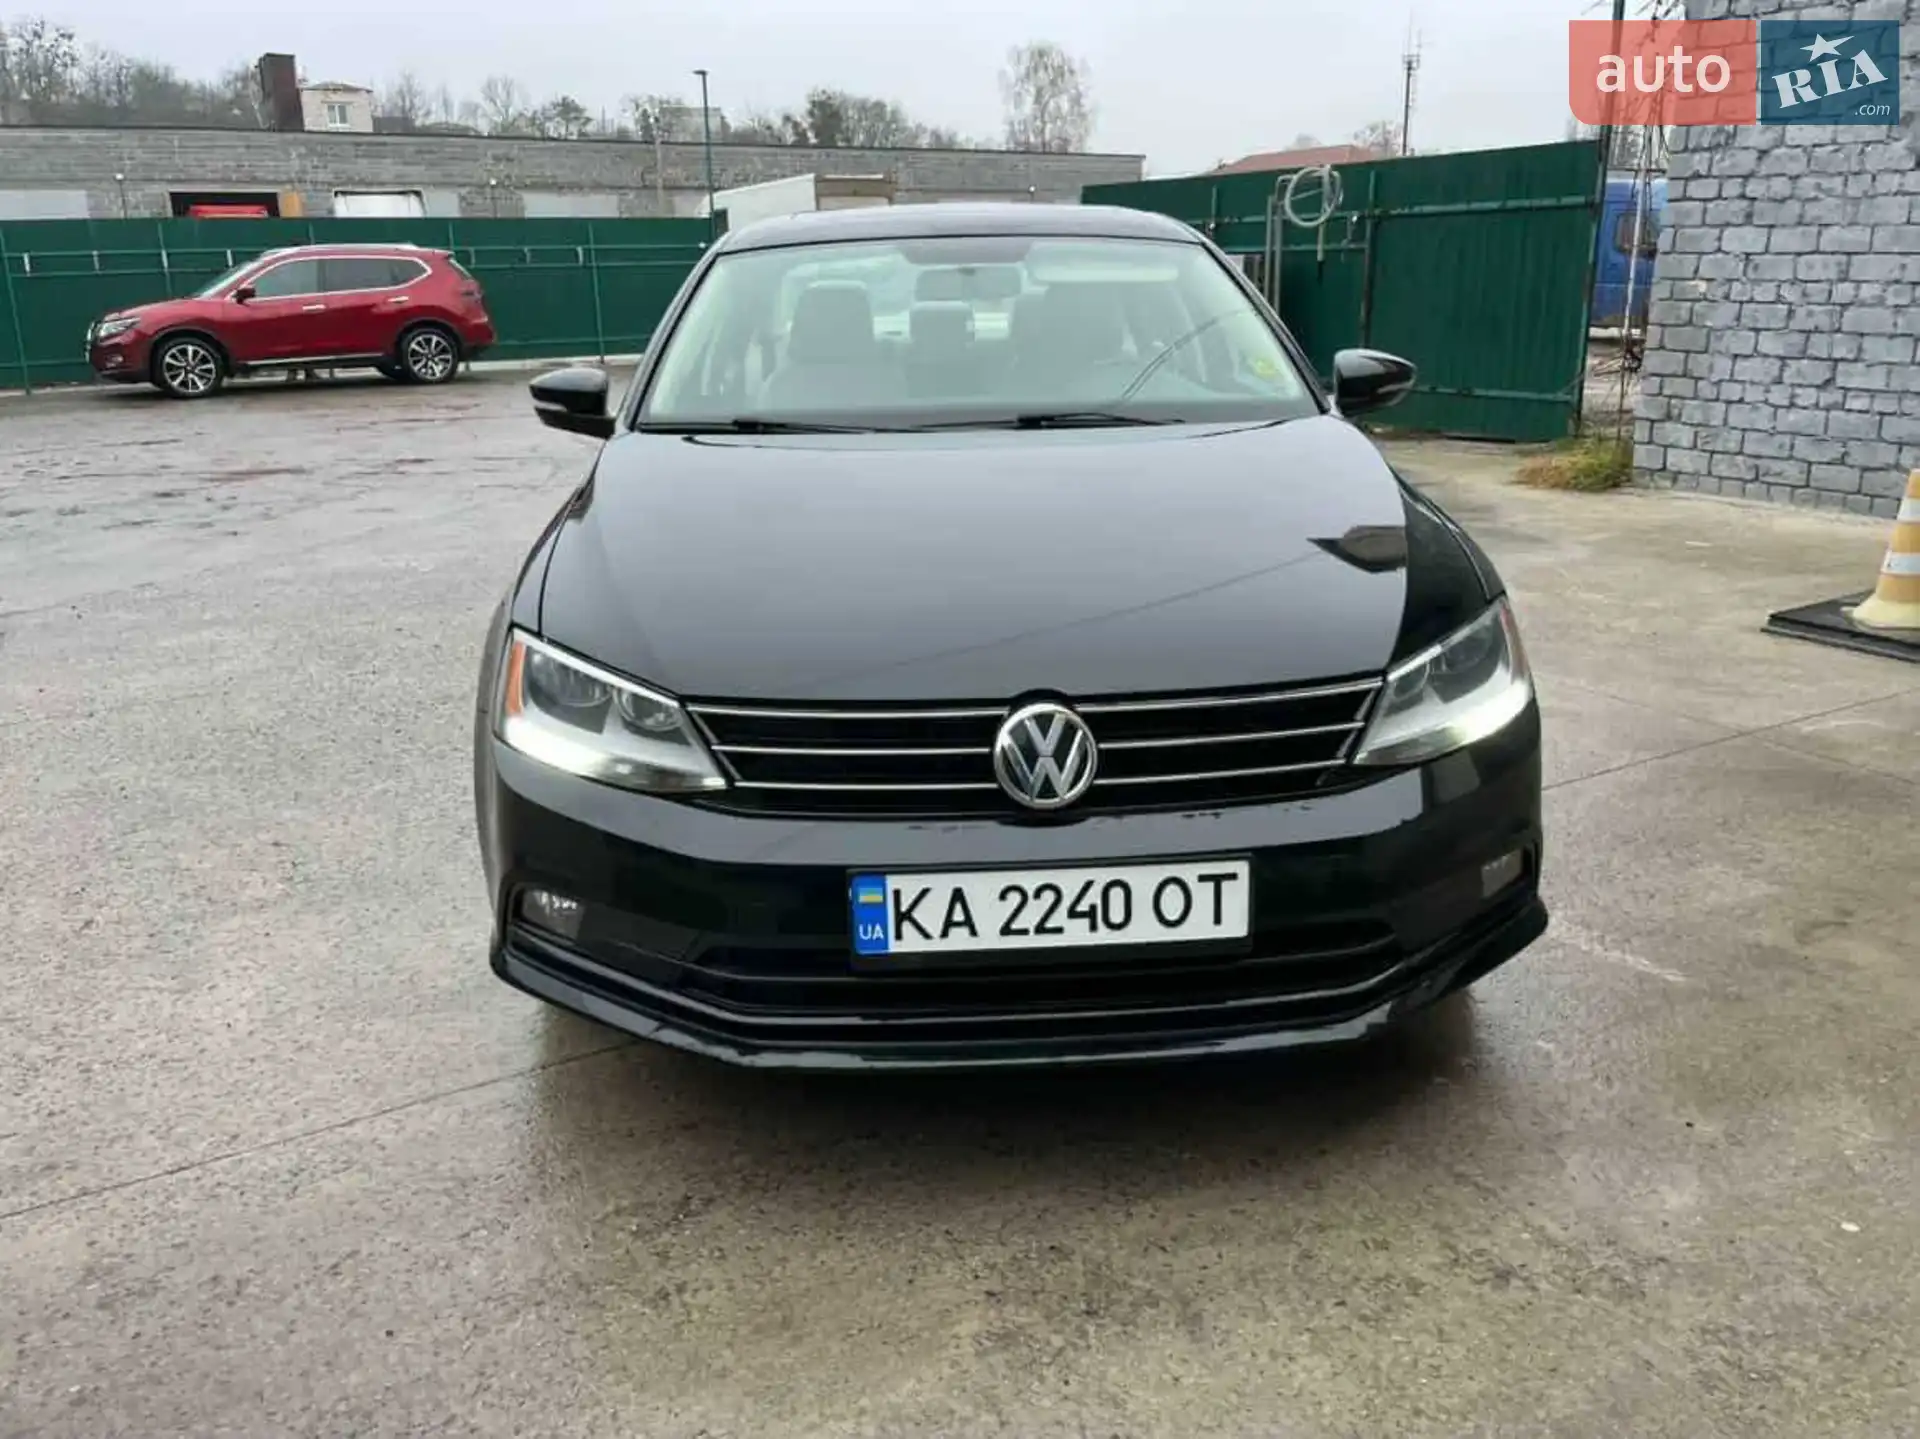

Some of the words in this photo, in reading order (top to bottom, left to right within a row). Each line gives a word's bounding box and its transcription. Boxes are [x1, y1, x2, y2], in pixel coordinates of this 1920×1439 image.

[892, 887, 979, 941] KA
[998, 879, 1133, 936] 2240
[1152, 872, 1238, 928] OT
[859, 925, 884, 941] UA
